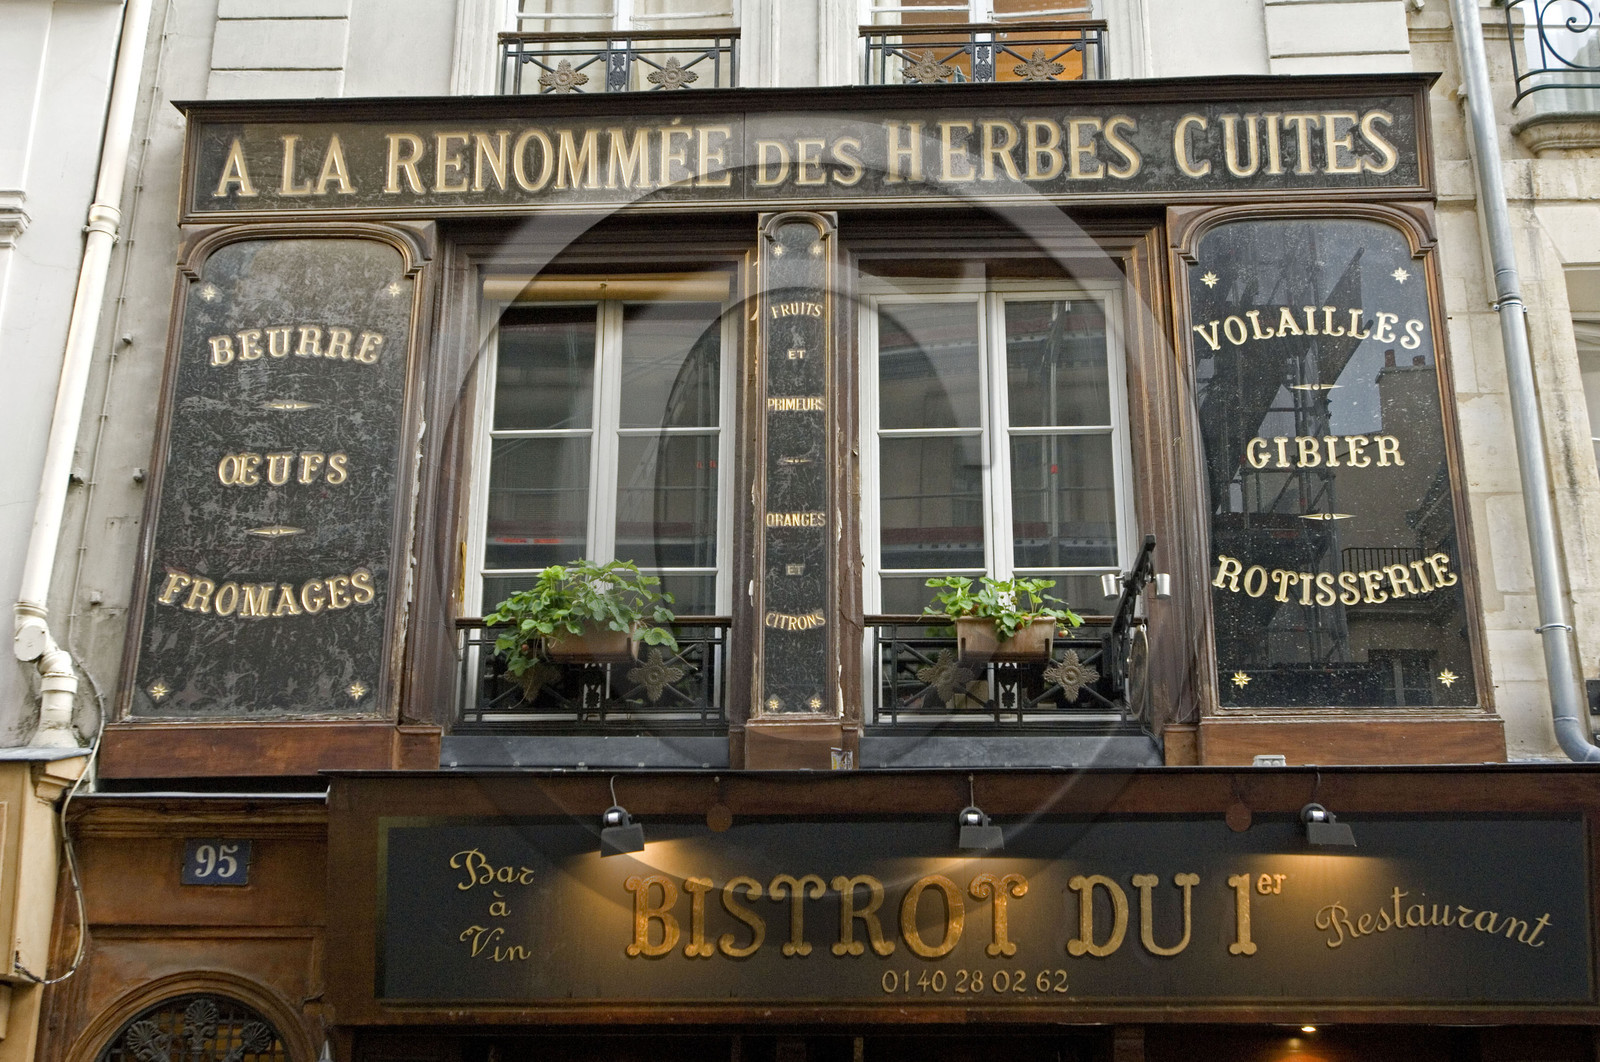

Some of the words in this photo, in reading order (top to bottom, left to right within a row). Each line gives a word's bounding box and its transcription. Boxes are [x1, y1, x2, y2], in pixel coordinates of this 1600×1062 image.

[213, 139, 257, 197] A
[278, 133, 357, 196] LA
[383, 117, 733, 196] RENOMMÉE
[755, 136, 863, 187] DES
[883, 114, 1142, 185] HERBES
[1173, 109, 1400, 178] CUITES
[771, 302, 824, 319] FRUITS
[1192, 306, 1424, 351] VOLAILLES
[209, 327, 384, 367] BEURRE
[788, 350, 806, 360] ET
[767, 397, 825, 411] PRIMEURS
[218, 453, 348, 486] ŒUFS
[1246, 435, 1406, 469] GIBIER
[766, 512, 826, 528] ORANGES
[787, 564, 806, 576] ET
[1212, 553, 1458, 607] ROTISSERIE
[159, 572, 376, 618] FROMAGES
[765, 612, 826, 631] CITRONS
[194, 843, 240, 879] 95
[449, 847, 535, 891] Bar
[489, 890, 511, 917] à
[625, 873, 1029, 958] BISTROT
[1067, 872, 1200, 957] DU
[1314, 885, 1553, 949] Restaurant
[460, 925, 531, 962] Vin
[954, 969, 984, 993] 28
[992, 969, 1027, 993] 02
[1036, 969, 1069, 993] 62
